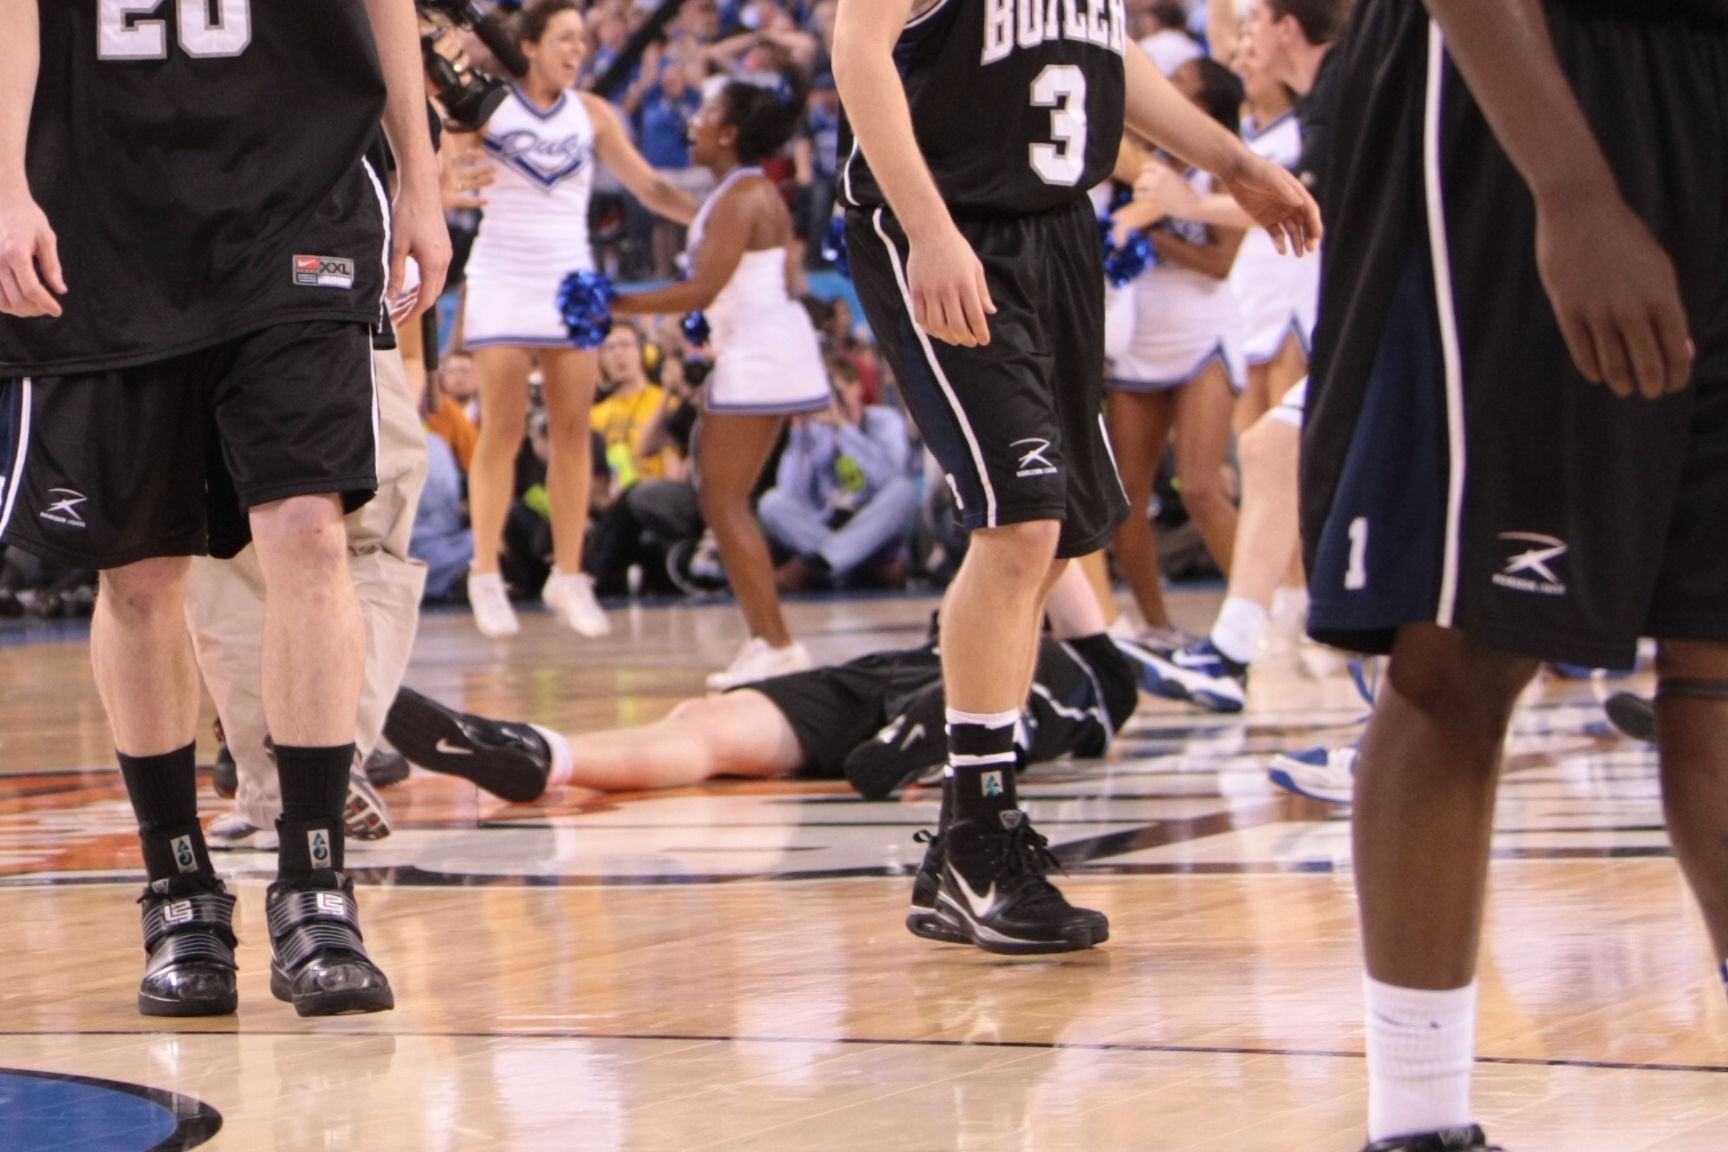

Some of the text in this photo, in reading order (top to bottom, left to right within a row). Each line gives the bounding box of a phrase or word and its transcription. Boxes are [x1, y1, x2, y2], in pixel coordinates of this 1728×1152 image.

[1029, 64, 1087, 186] 3
[319, 261, 351, 275] XXL
[1344, 516, 1369, 590] 1
